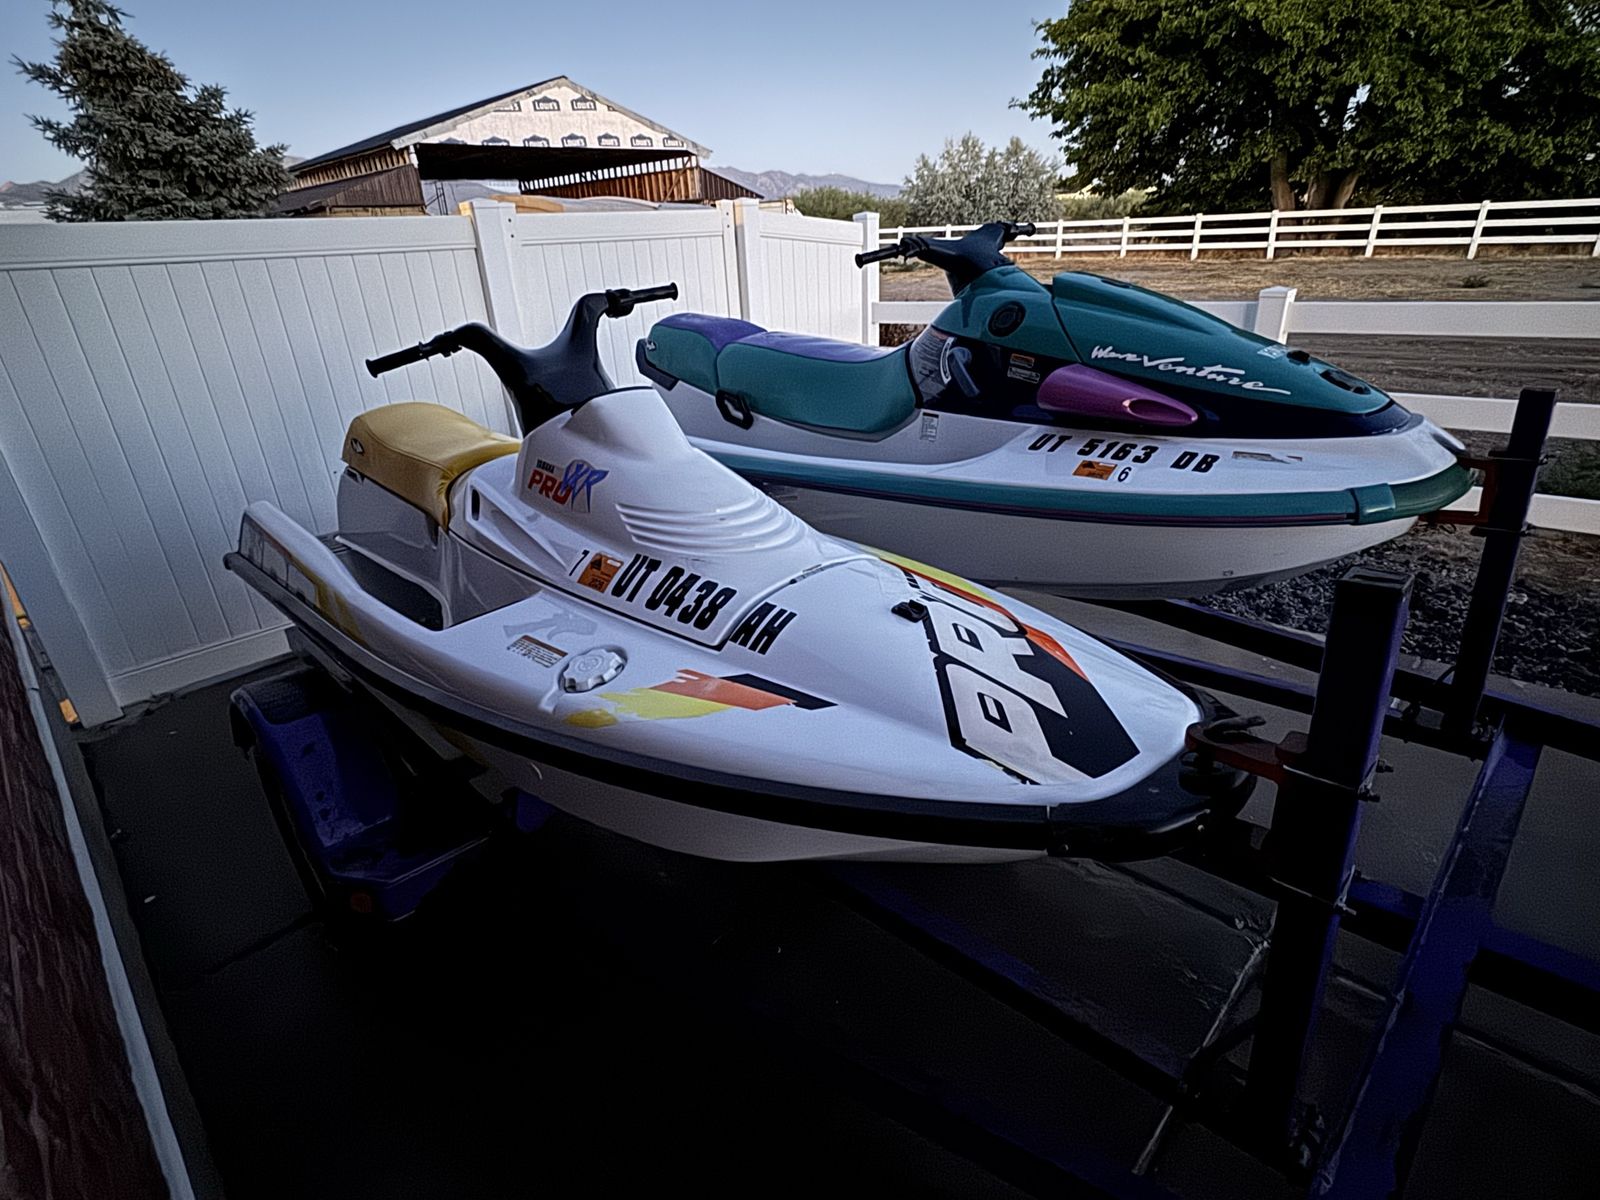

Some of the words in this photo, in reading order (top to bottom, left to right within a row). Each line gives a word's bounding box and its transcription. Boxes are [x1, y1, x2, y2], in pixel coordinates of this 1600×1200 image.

[1028, 433, 1072, 453] UT
[1077, 438, 1158, 464] 5163
[1170, 451, 1220, 473] DB
[527, 468, 573, 506] PRO
[1117, 466, 1132, 483] 6
[569, 549, 589, 576] 7
[611, 553, 662, 603] UT
[645, 565, 738, 631] 0438
[729, 601, 798, 656] AH
